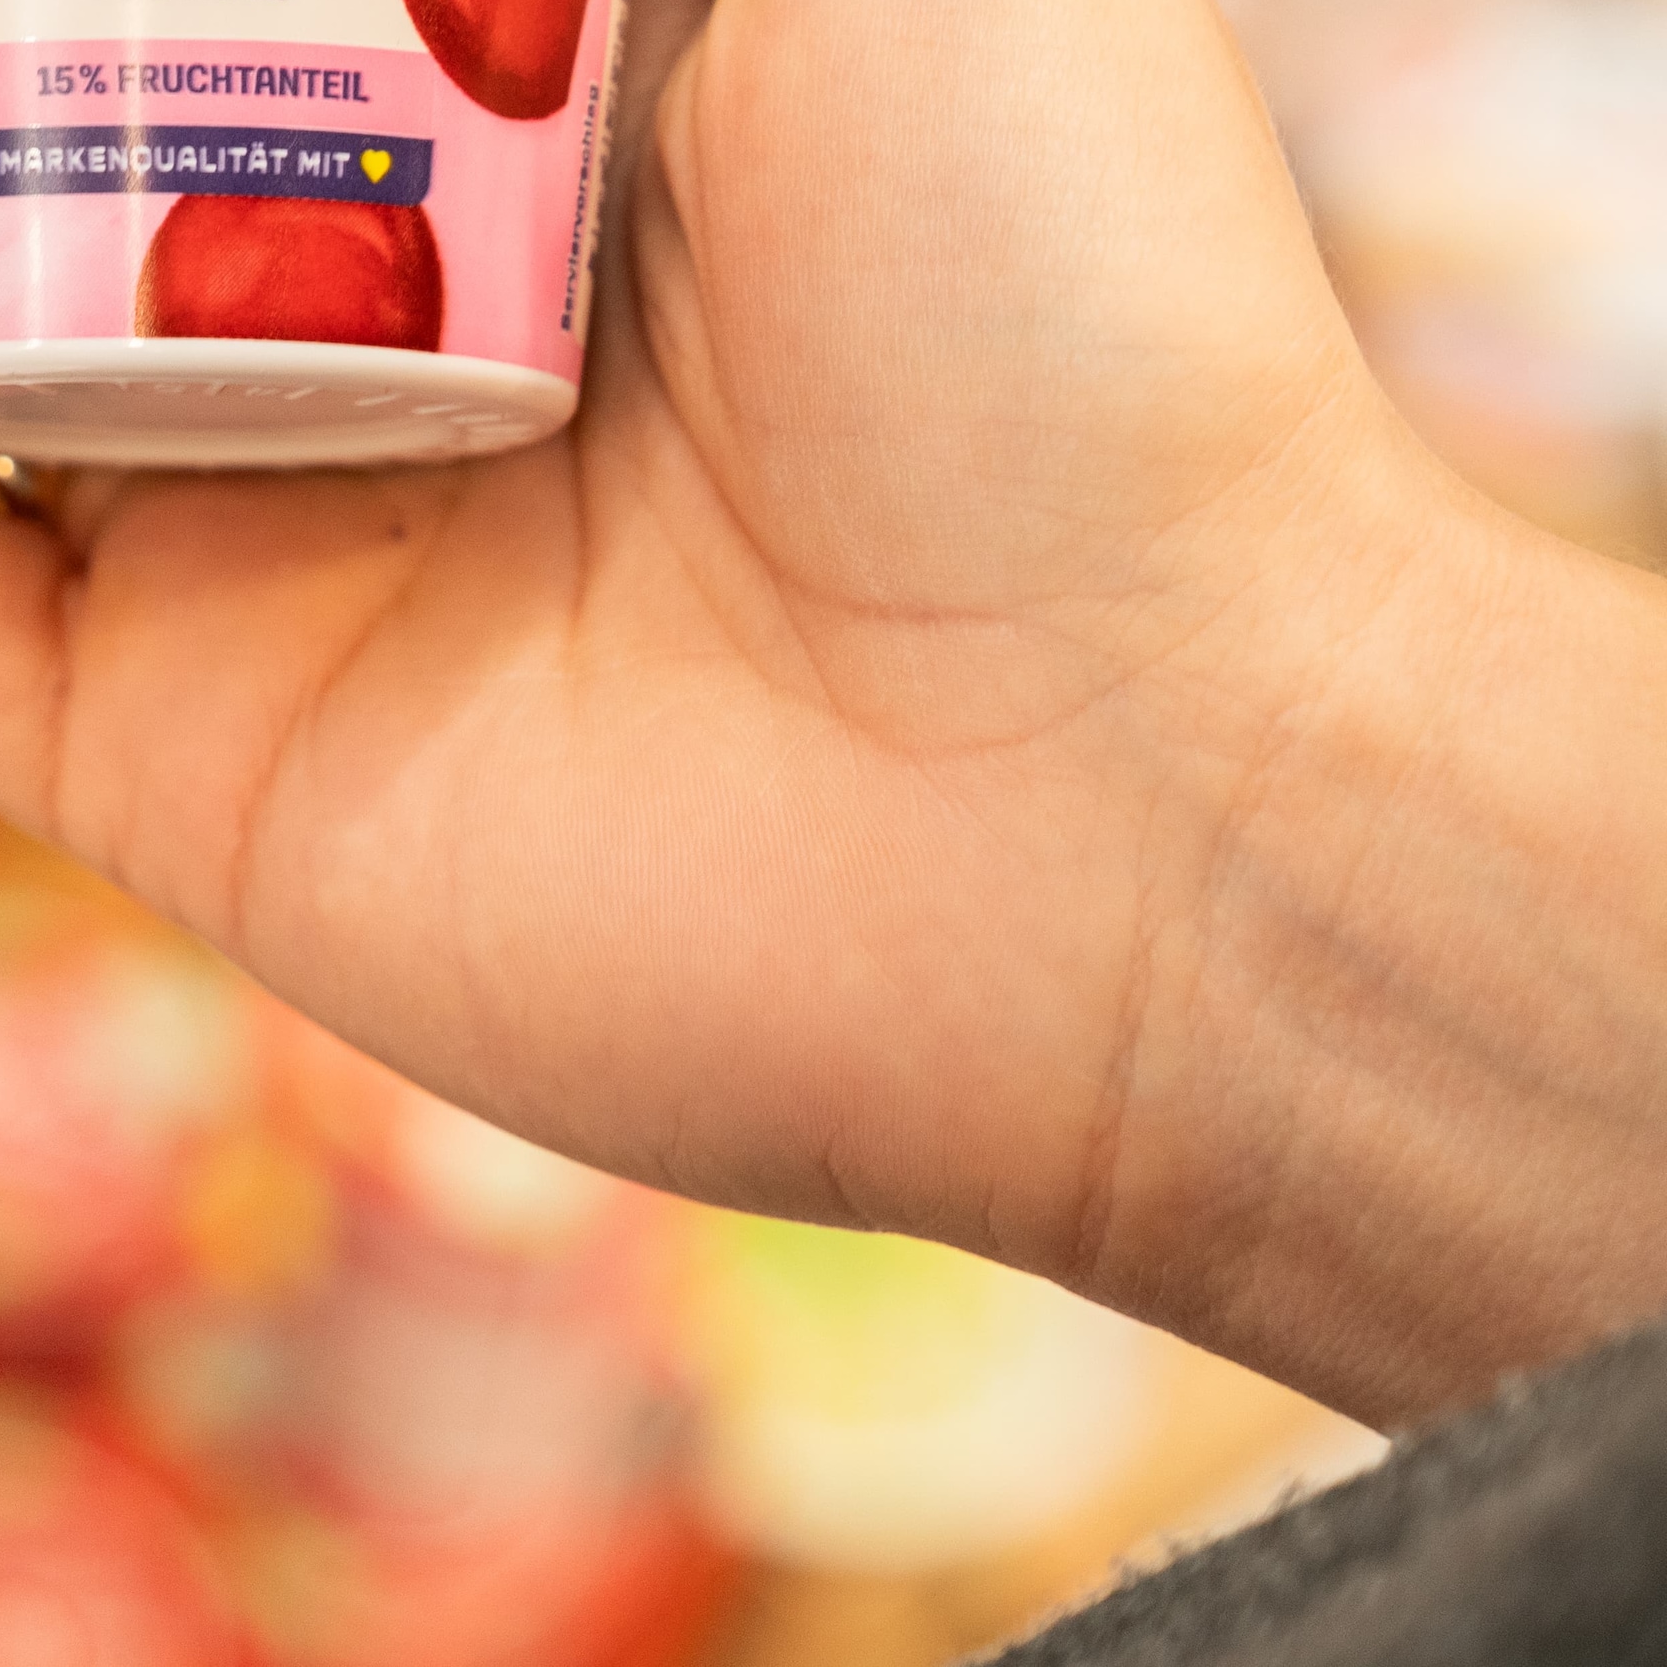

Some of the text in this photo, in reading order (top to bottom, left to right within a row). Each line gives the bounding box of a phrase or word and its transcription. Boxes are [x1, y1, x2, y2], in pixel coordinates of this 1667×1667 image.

[36, 64, 371, 103] 15% FRUCHTANTEIL
[297, 151, 351, 179] MIT
